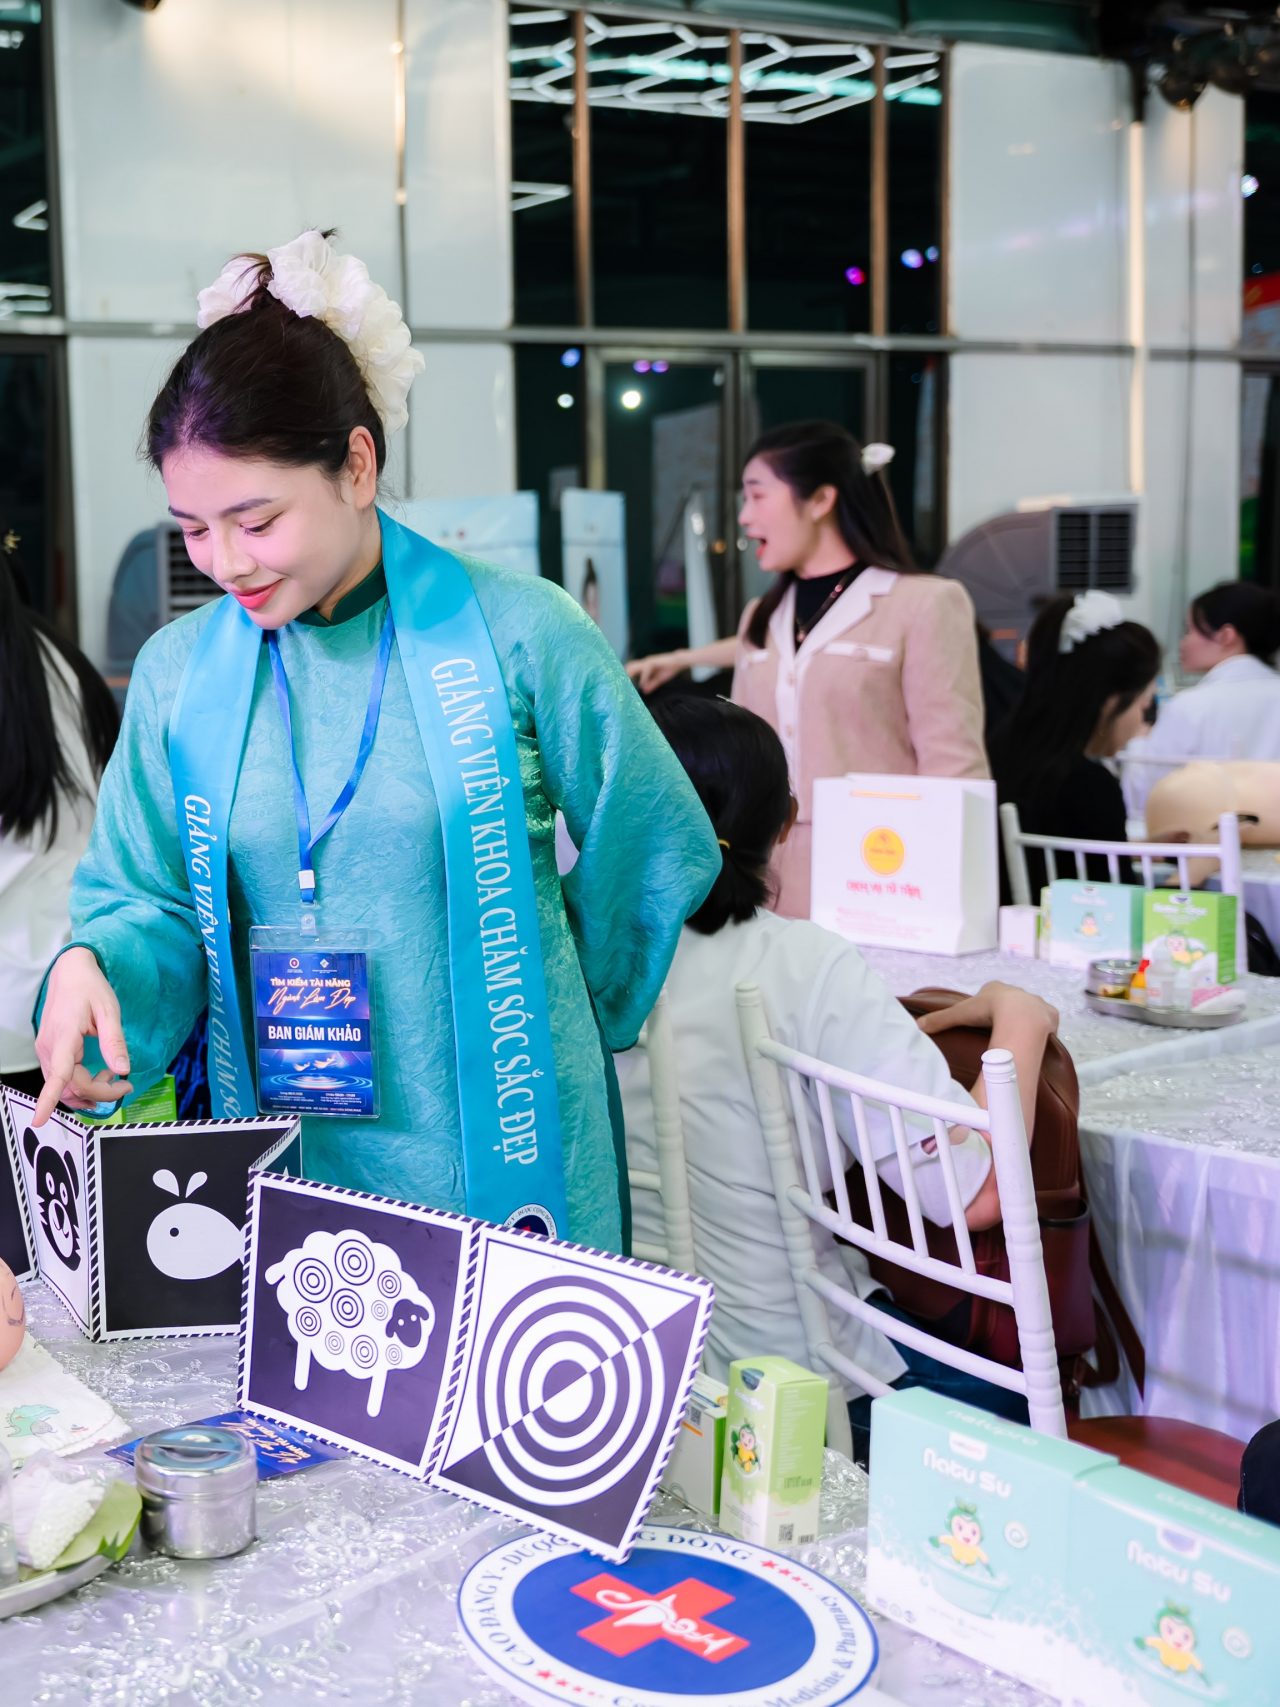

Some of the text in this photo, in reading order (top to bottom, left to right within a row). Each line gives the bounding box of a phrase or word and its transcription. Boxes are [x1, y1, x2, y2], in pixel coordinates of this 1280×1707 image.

[184, 794, 218, 880] GIẢNG
[194, 883, 219, 945] VIÊN
[431, 658, 544, 1166] GIẢNG VIÊN KHOA CHĂM SÓC SẮC ĐẸP
[270, 977, 351, 988] TÌM KIẾM TÀI NĂNG
[211, 1017, 239, 1095] CHĂM
[268, 1023, 362, 1042] BAN GIÁM KHẢO
[488, 1632, 536, 1666] CAO
